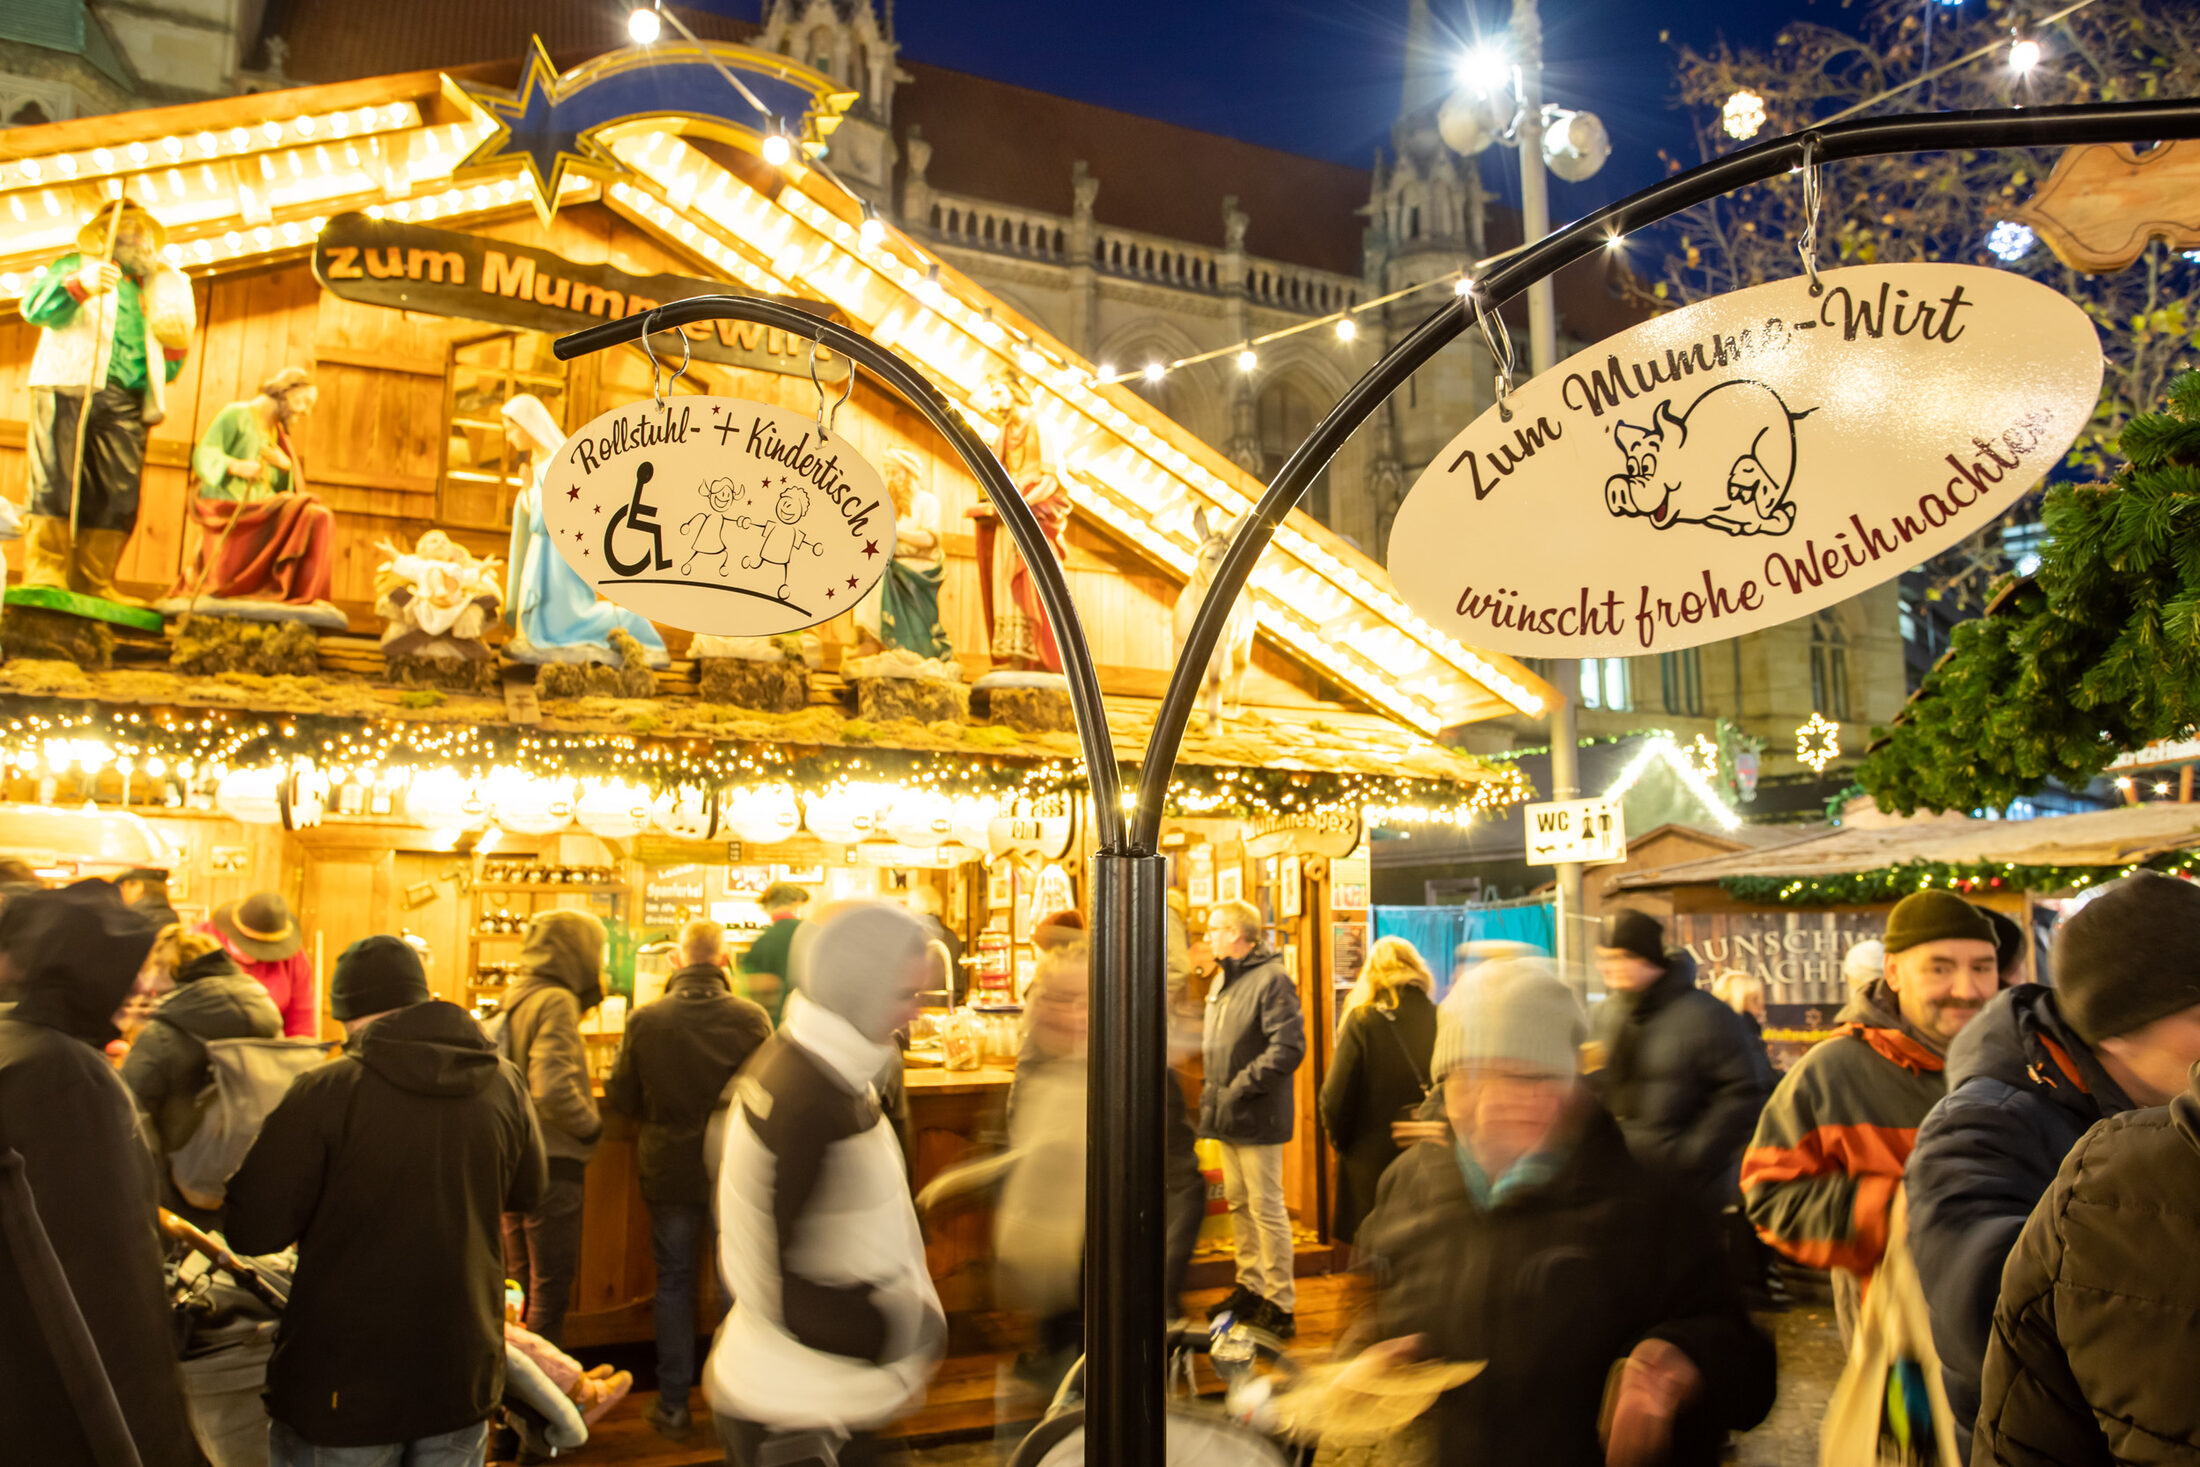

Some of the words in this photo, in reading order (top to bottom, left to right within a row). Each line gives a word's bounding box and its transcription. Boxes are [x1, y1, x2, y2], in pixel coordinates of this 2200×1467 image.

[327, 245, 465, 285] zum
[570, 406, 701, 475] Rollstuhl-
[714, 412, 740, 446] +
[746, 417, 880, 538] Kindertisch
[1448, 416, 1562, 500] Zum
[1457, 585, 1625, 636] wünscht
[1635, 568, 1764, 648] frohe
[1537, 811, 1569, 833] WC
